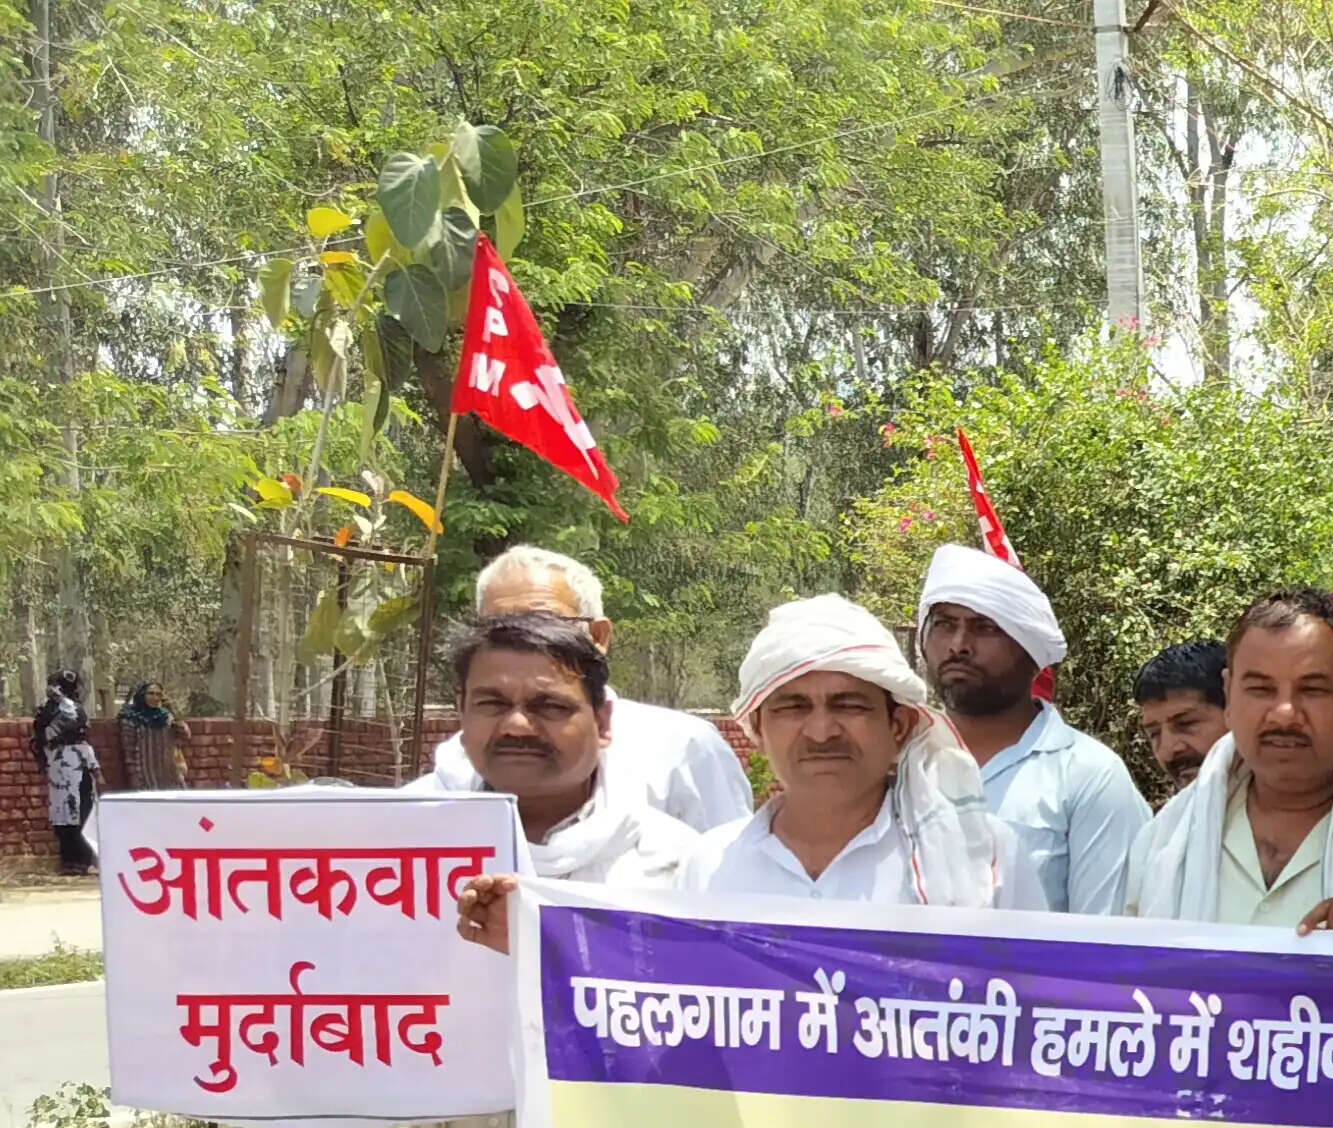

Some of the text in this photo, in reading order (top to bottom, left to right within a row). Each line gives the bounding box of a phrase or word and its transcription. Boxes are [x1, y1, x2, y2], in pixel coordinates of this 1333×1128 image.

[177, 962, 451, 1093] मुर्दाबाद
[571, 977, 785, 1050] पहलगाम
[795, 968, 845, 1053] में
[853, 978, 1022, 1066] आतंकी
[1031, 989, 1162, 1078] हमले
[1170, 992, 1222, 1077] में
